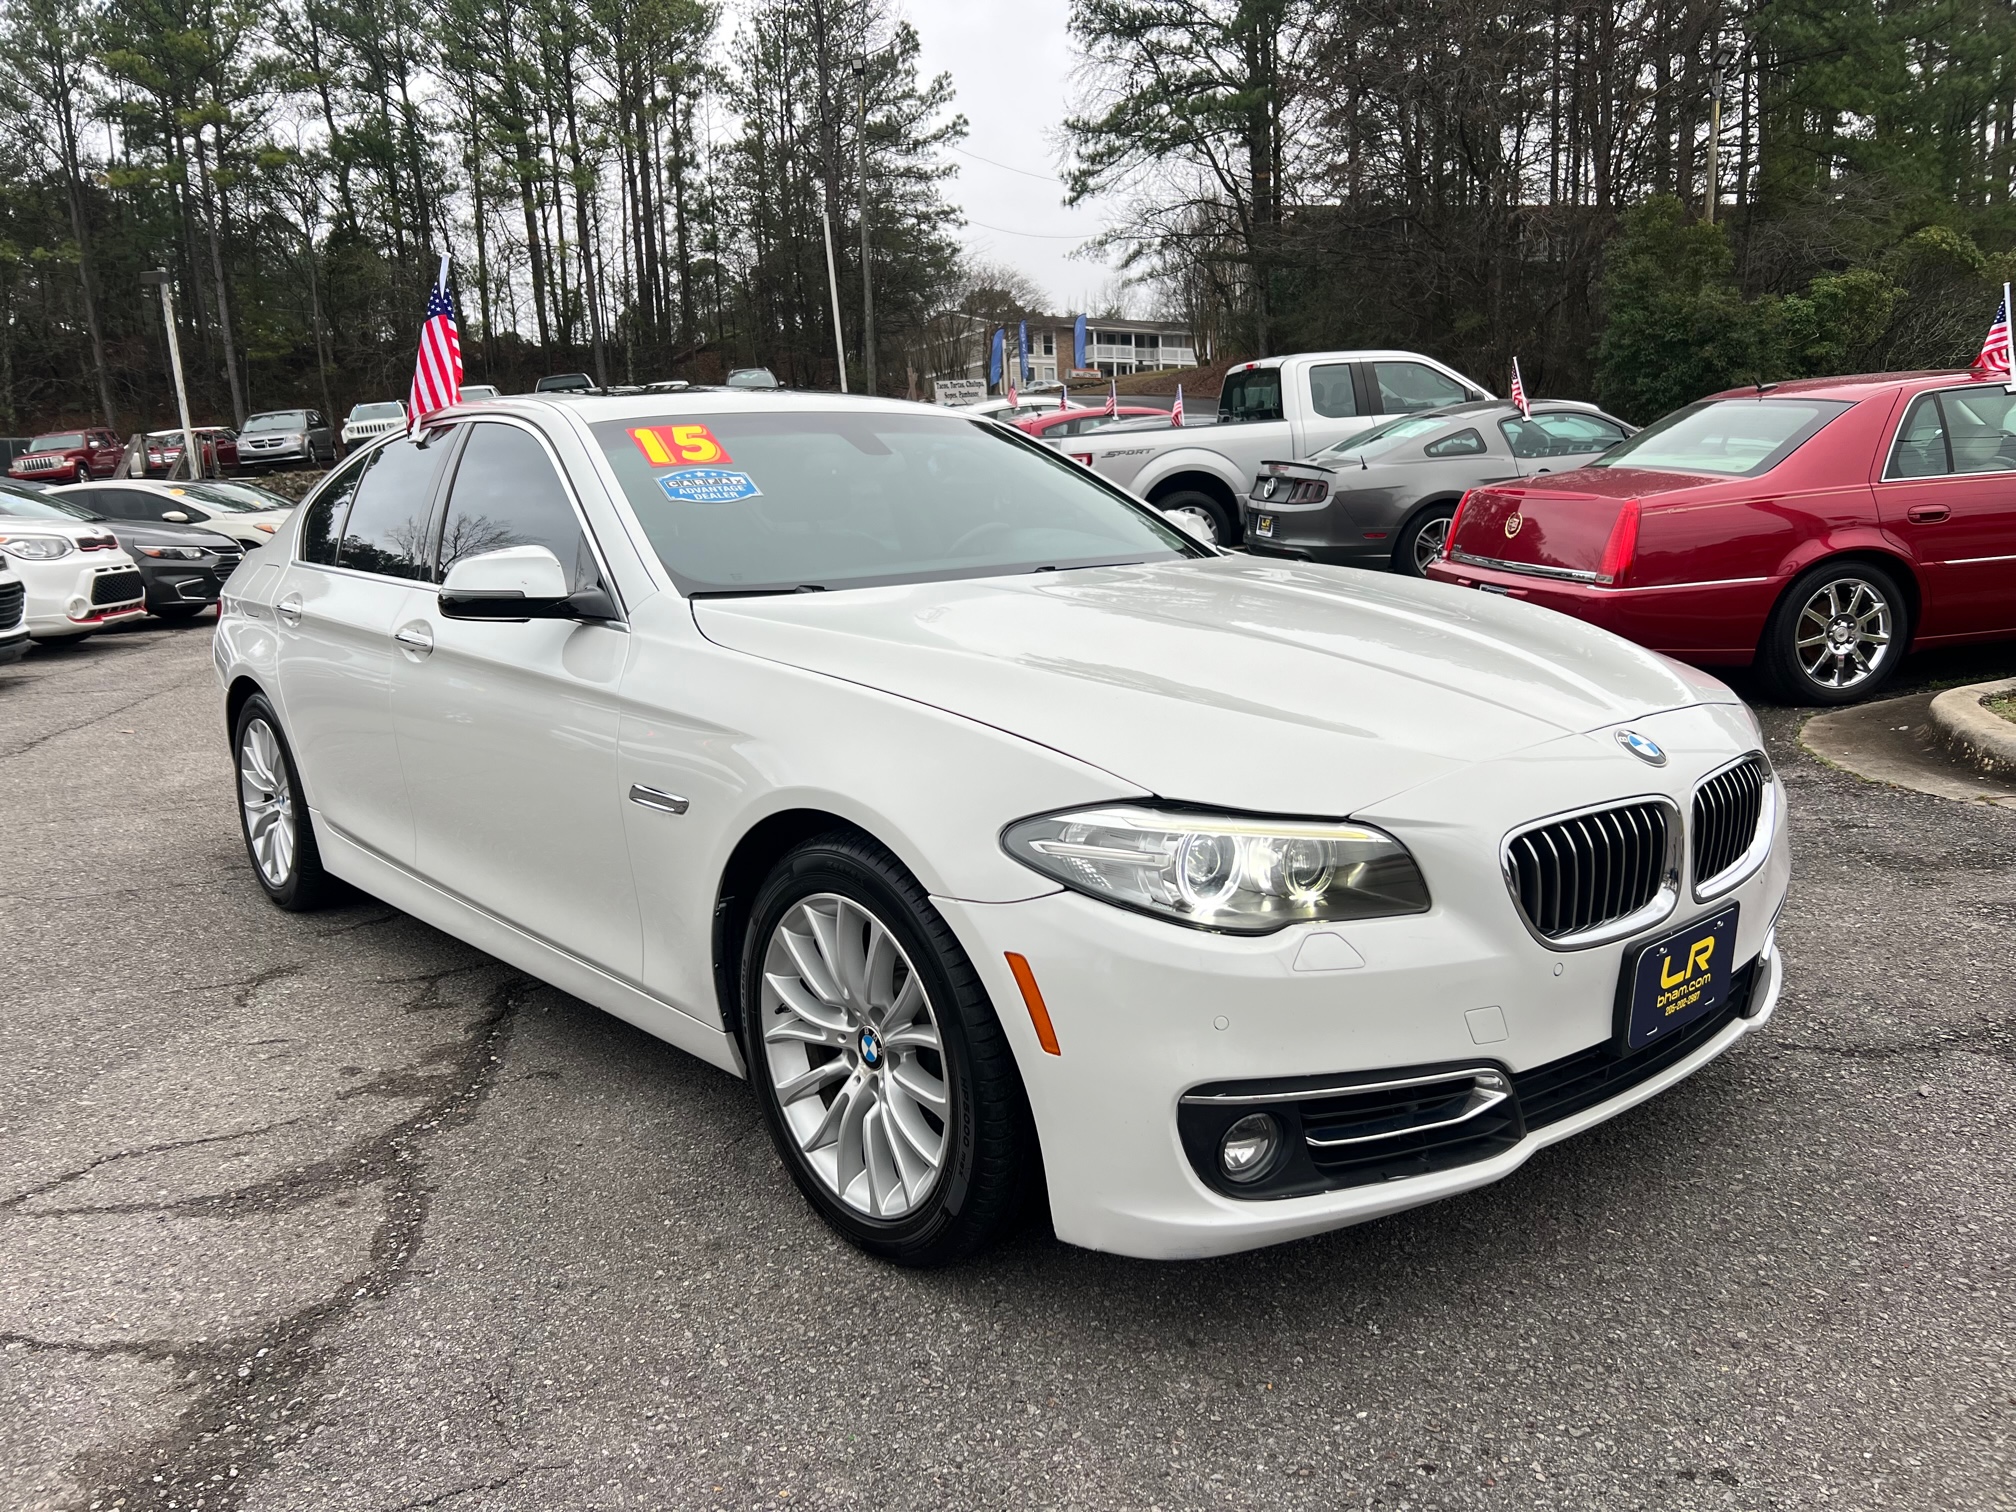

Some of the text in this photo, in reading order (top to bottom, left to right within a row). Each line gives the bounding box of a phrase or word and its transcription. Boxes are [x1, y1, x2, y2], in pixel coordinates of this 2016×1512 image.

[634, 425, 721, 464] 15
[1101, 447, 1155, 459] SPORT
[666, 477, 746, 488] CARFAX
[678, 485, 745, 495] ADVANTAGE
[693, 491, 739, 500] DEALER
[1660, 935, 1715, 990] LR
[1656, 973, 1711, 1008] bham.com
[960, 1076, 971, 1148] HP5000
